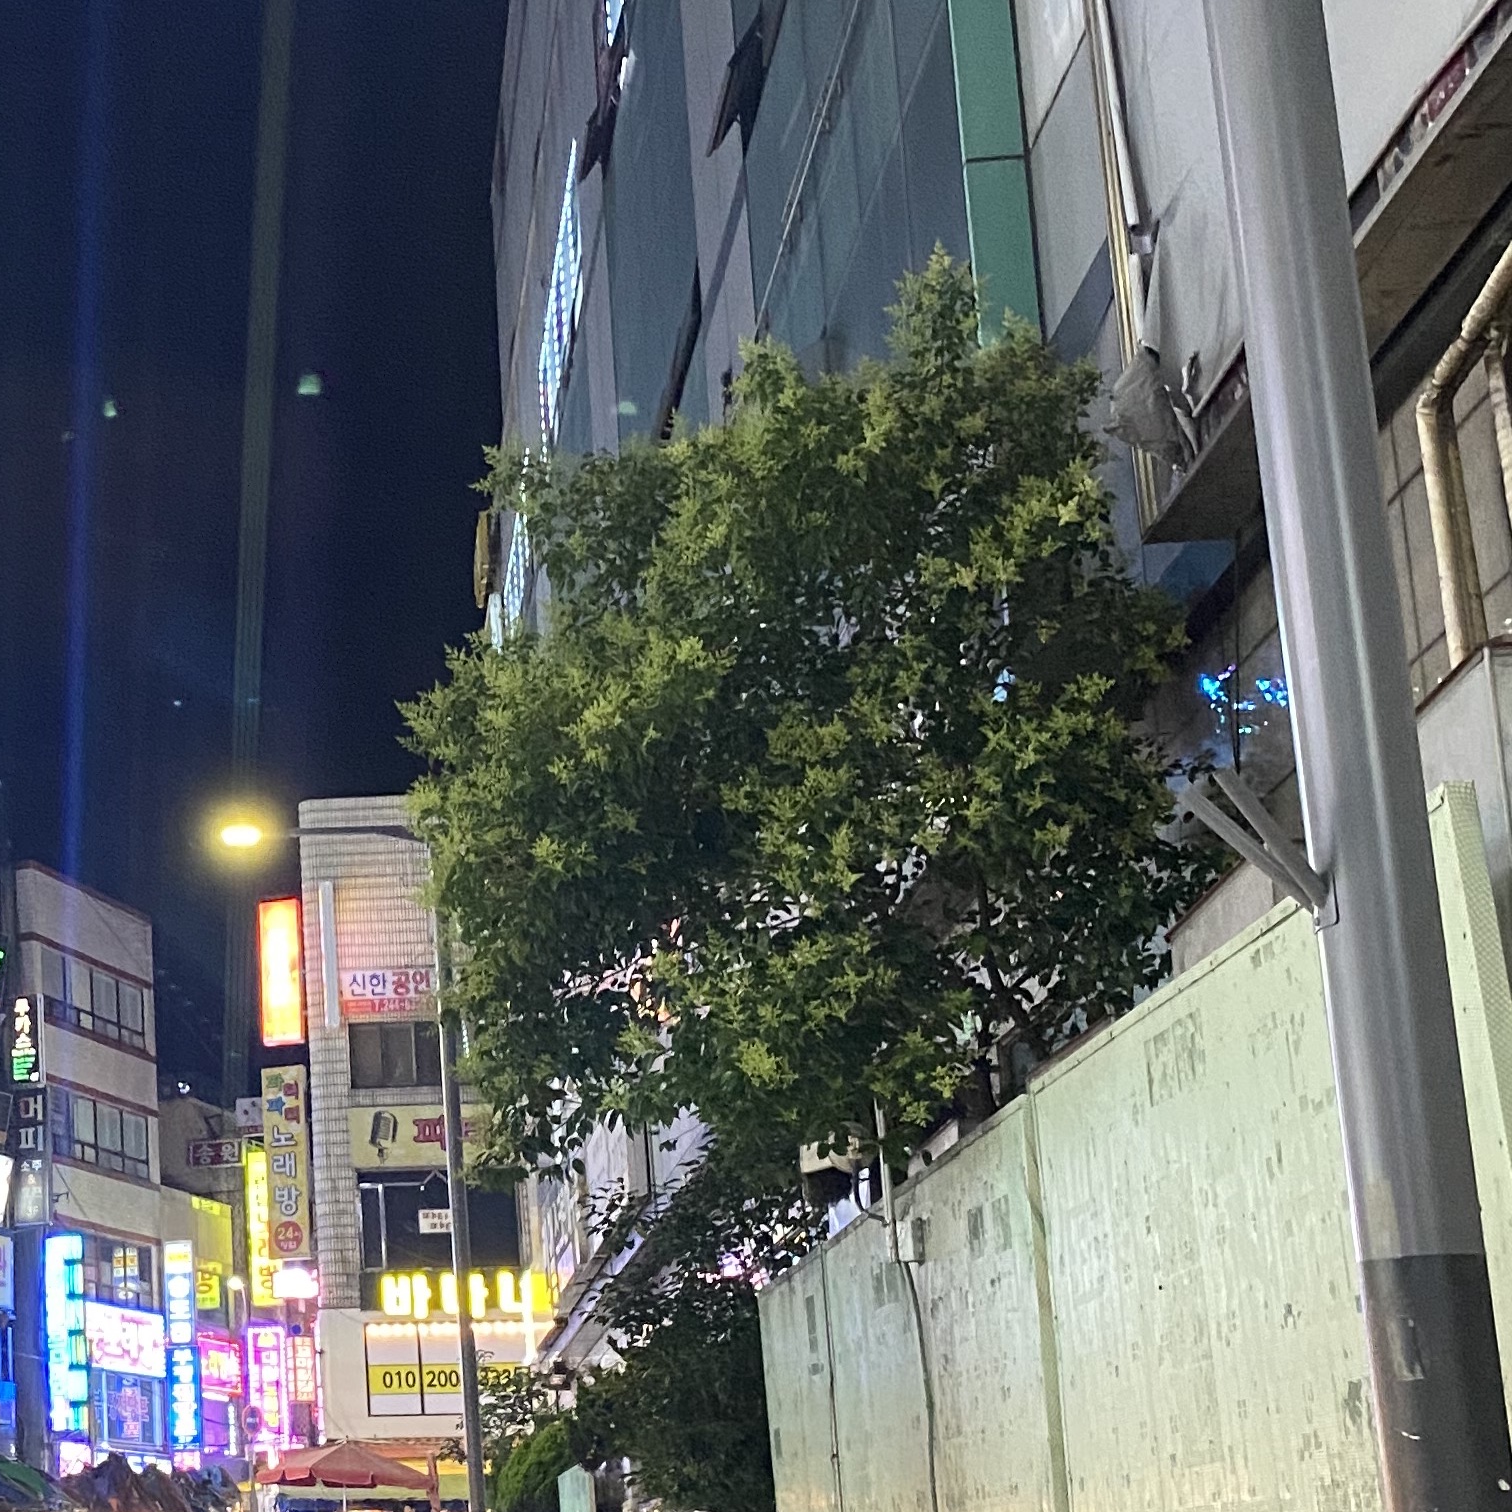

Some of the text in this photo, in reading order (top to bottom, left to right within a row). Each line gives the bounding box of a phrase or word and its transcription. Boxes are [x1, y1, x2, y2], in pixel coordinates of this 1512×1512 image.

[349, 971, 386, 997] 신한
[270, 1125, 301, 1217] 노래방
[382, 1370, 417, 1389] 010
[425, 1370, 461, 1388] 200
